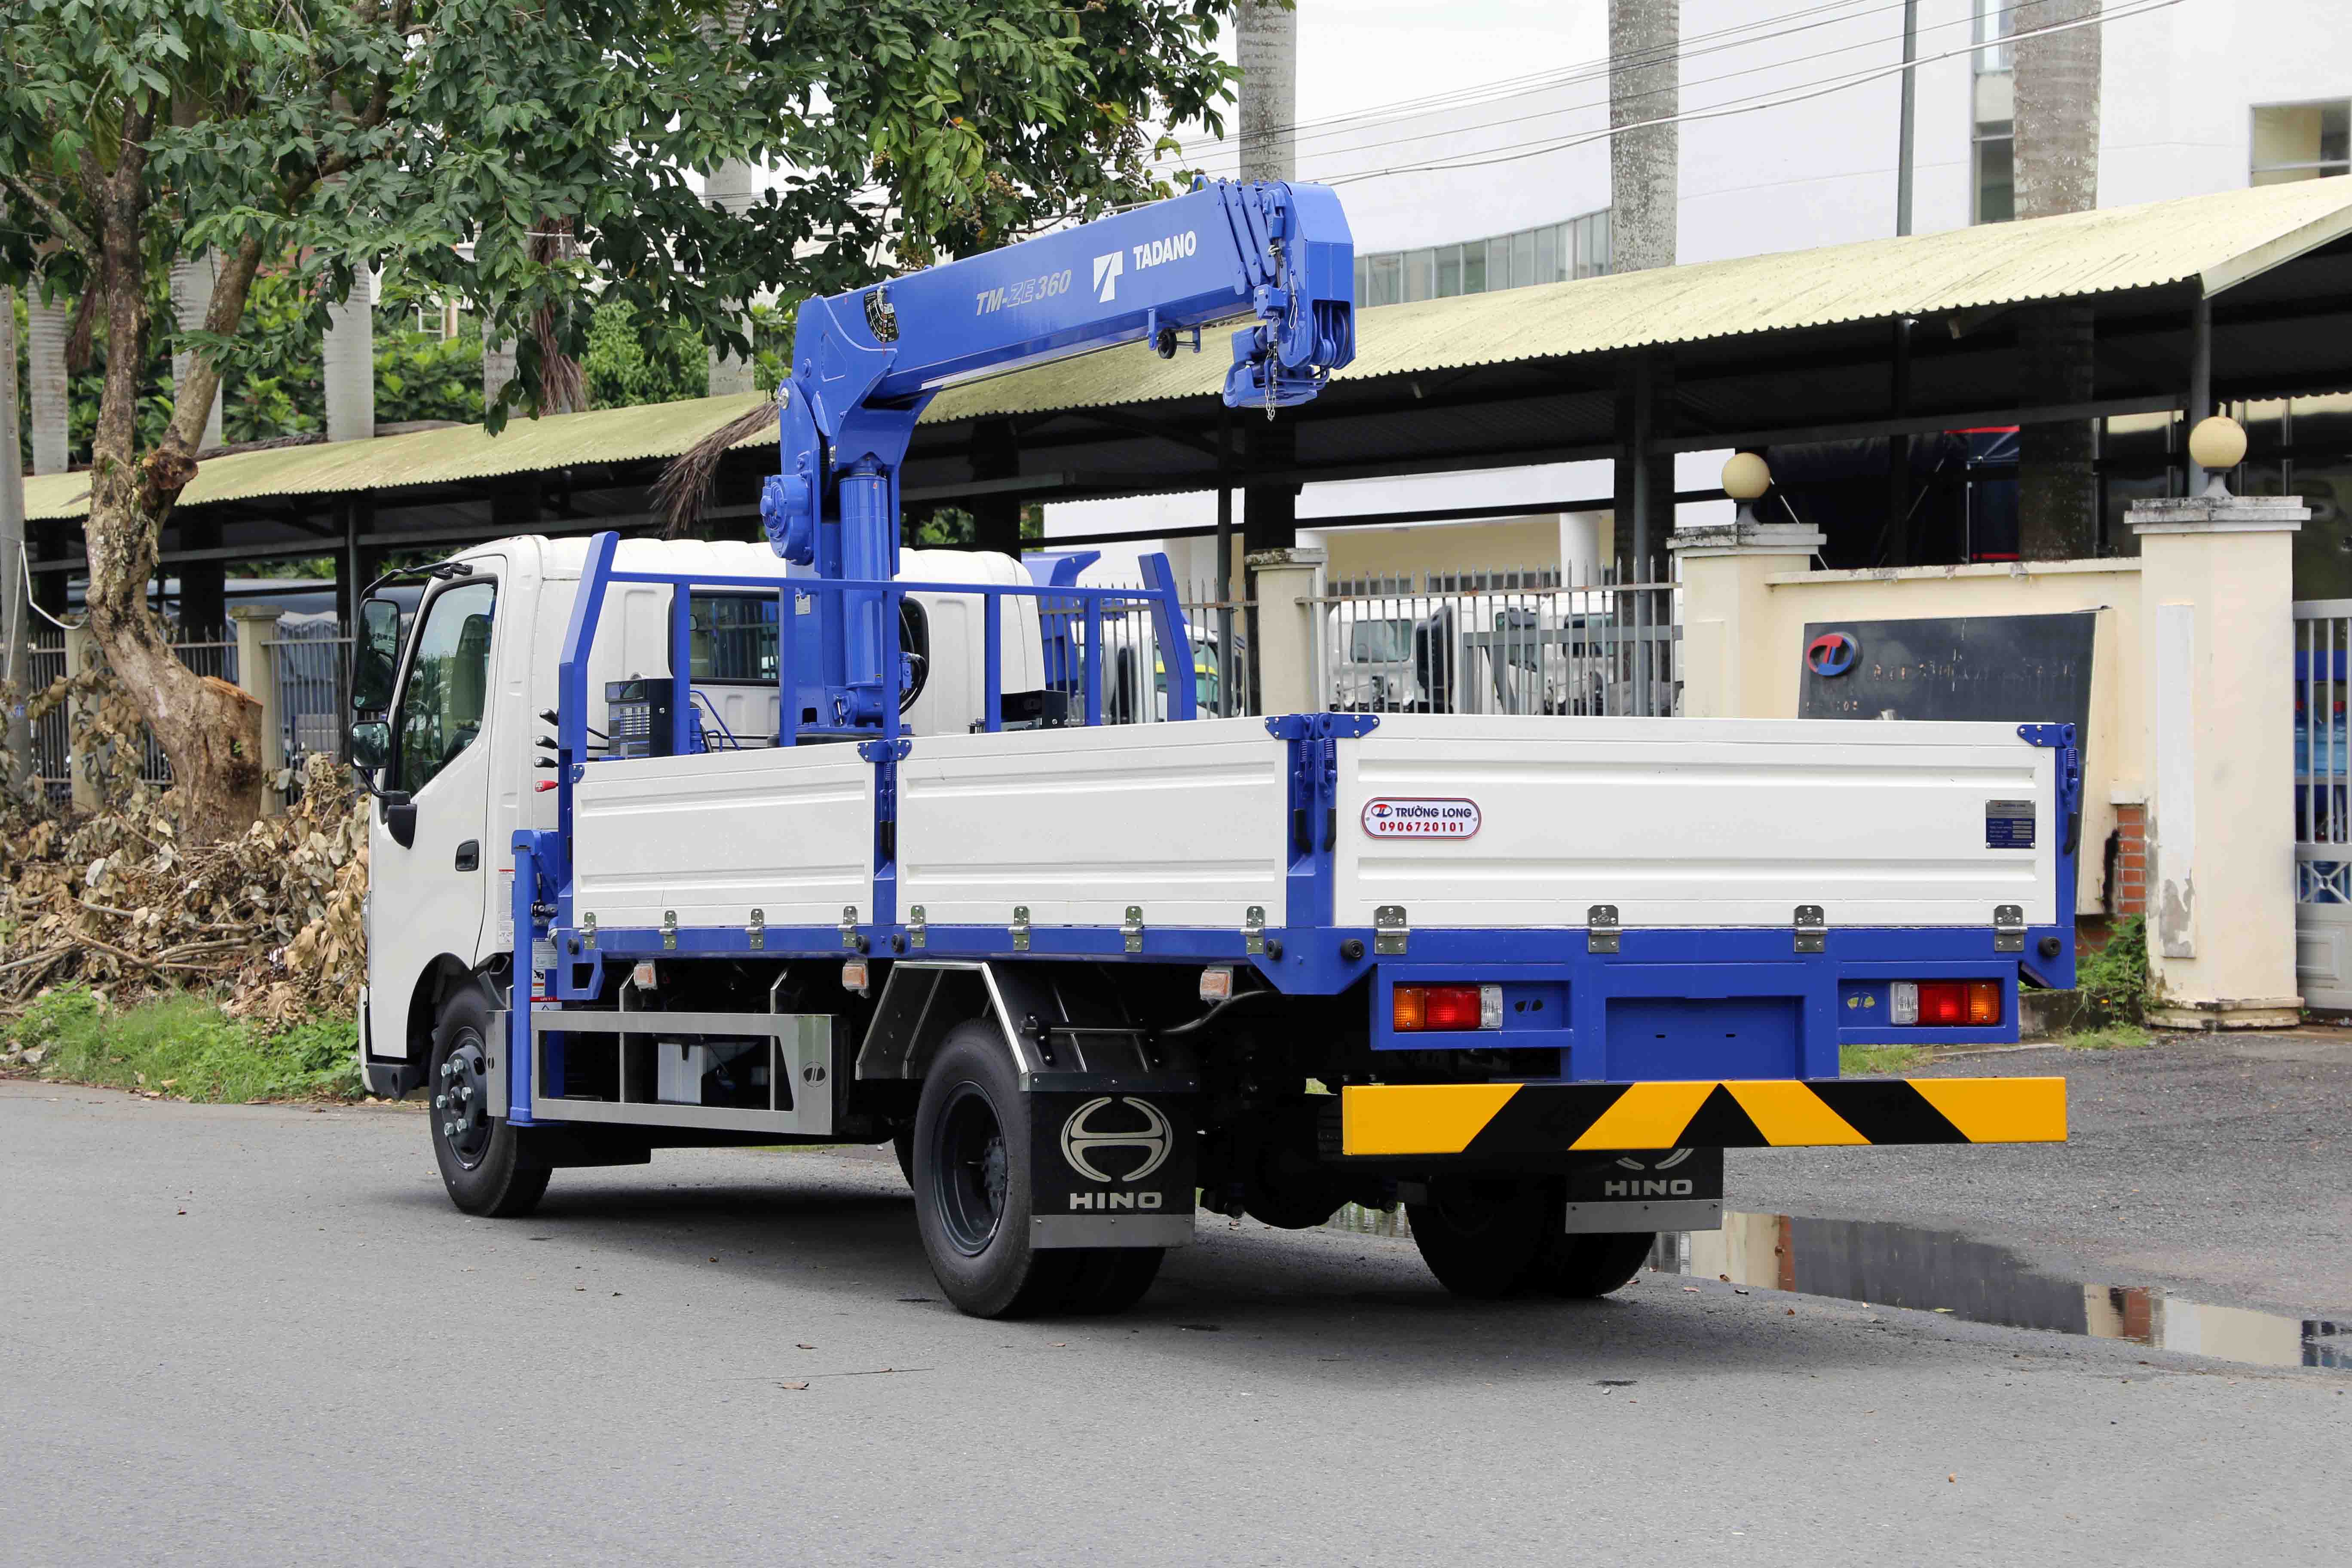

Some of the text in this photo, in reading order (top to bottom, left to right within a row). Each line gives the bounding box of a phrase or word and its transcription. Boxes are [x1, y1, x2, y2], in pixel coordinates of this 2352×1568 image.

[1133, 230, 1197, 270] TADANO
[1395, 805, 1472, 818] TRƯỜNG LONG
[1379, 821, 1464, 832] 0906720101
[1605, 1179, 1693, 1196] HINO
[1069, 1192, 1162, 1210] HINO
